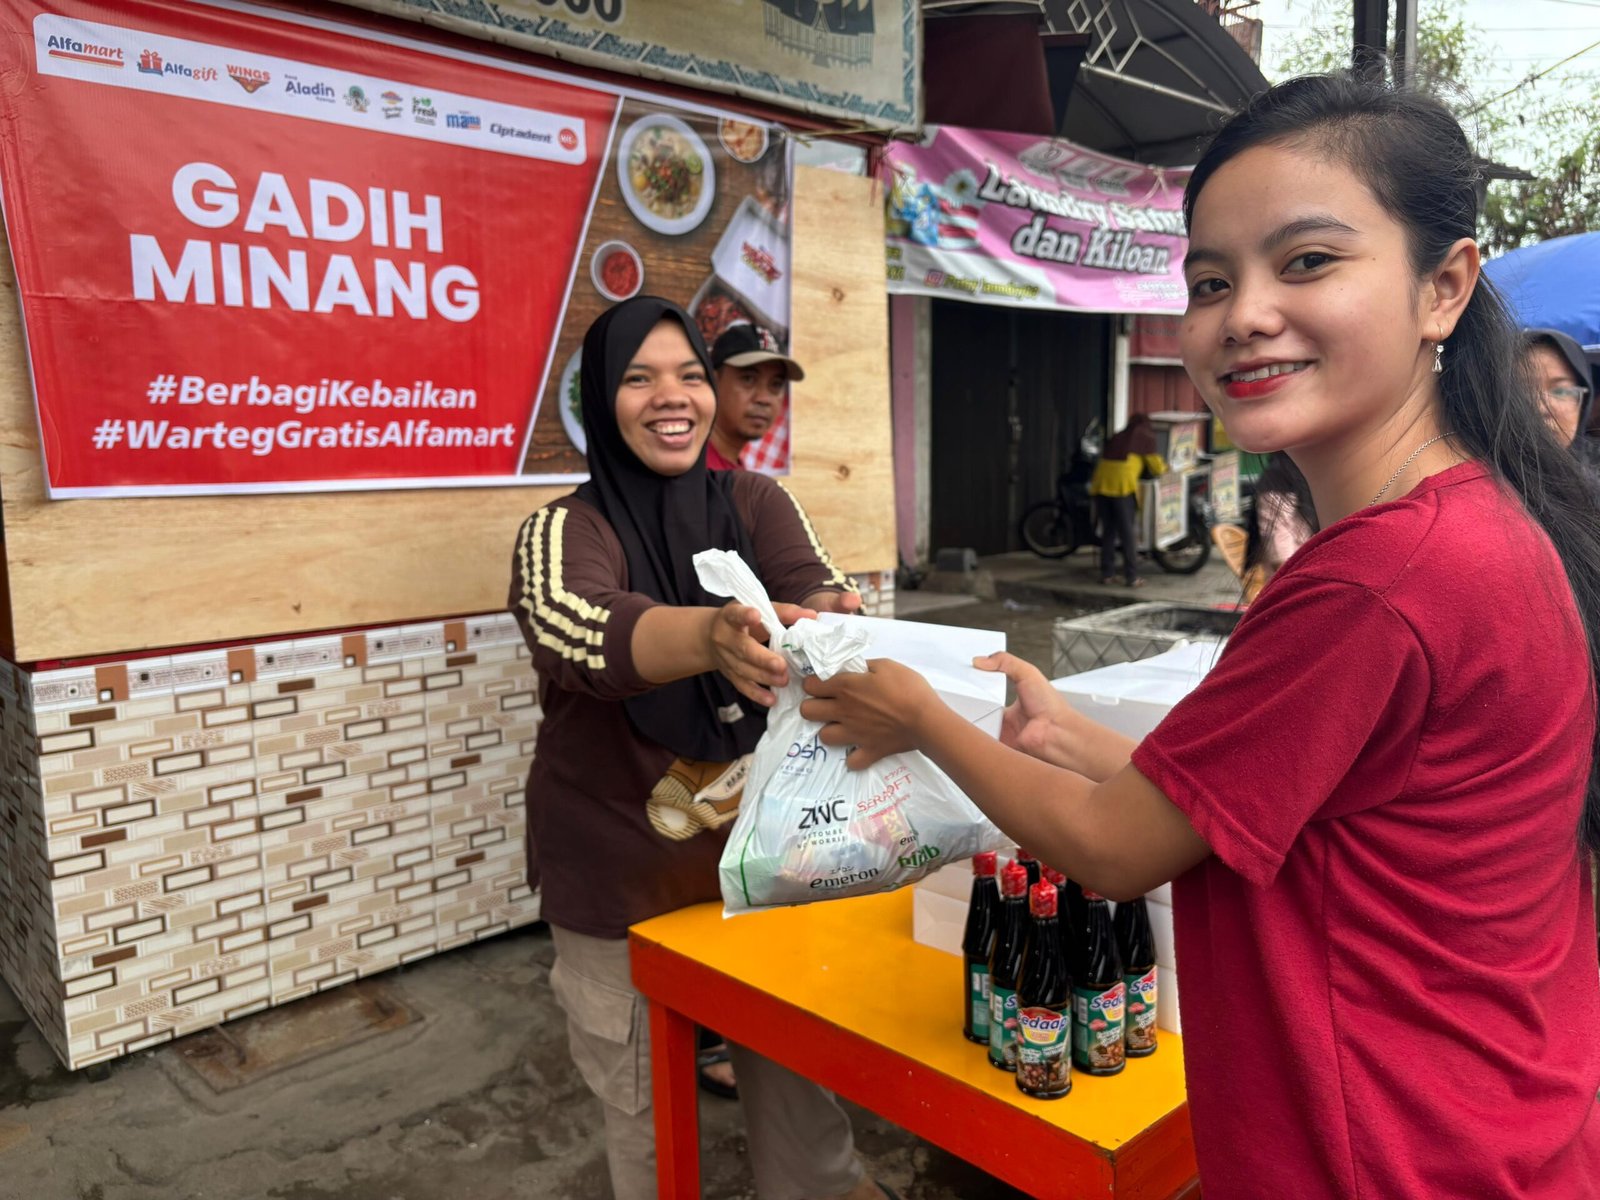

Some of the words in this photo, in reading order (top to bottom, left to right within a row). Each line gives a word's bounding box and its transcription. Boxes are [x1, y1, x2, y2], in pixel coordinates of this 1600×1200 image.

[48, 35, 123, 60] Alfamart
[164, 61, 218, 82] Alfagift
[226, 63, 271, 81] WINGS
[285, 80, 335, 97] Aladin
[412, 107, 437, 118] Fresh
[490, 123, 552, 144] Ciptadent
[979, 162, 1110, 229] Laundry
[172, 162, 444, 253] GADIH
[1012, 213, 1080, 263] dan
[1082, 229, 1170, 275] Kiloan
[130, 234, 480, 322] MINANG
[147, 374, 477, 413] #BerbagiKebaikan
[92, 419, 515, 456] #WartegGratisAlfamart
[809, 867, 880, 889] emeron
[1017, 1012, 1068, 1031] edaap
